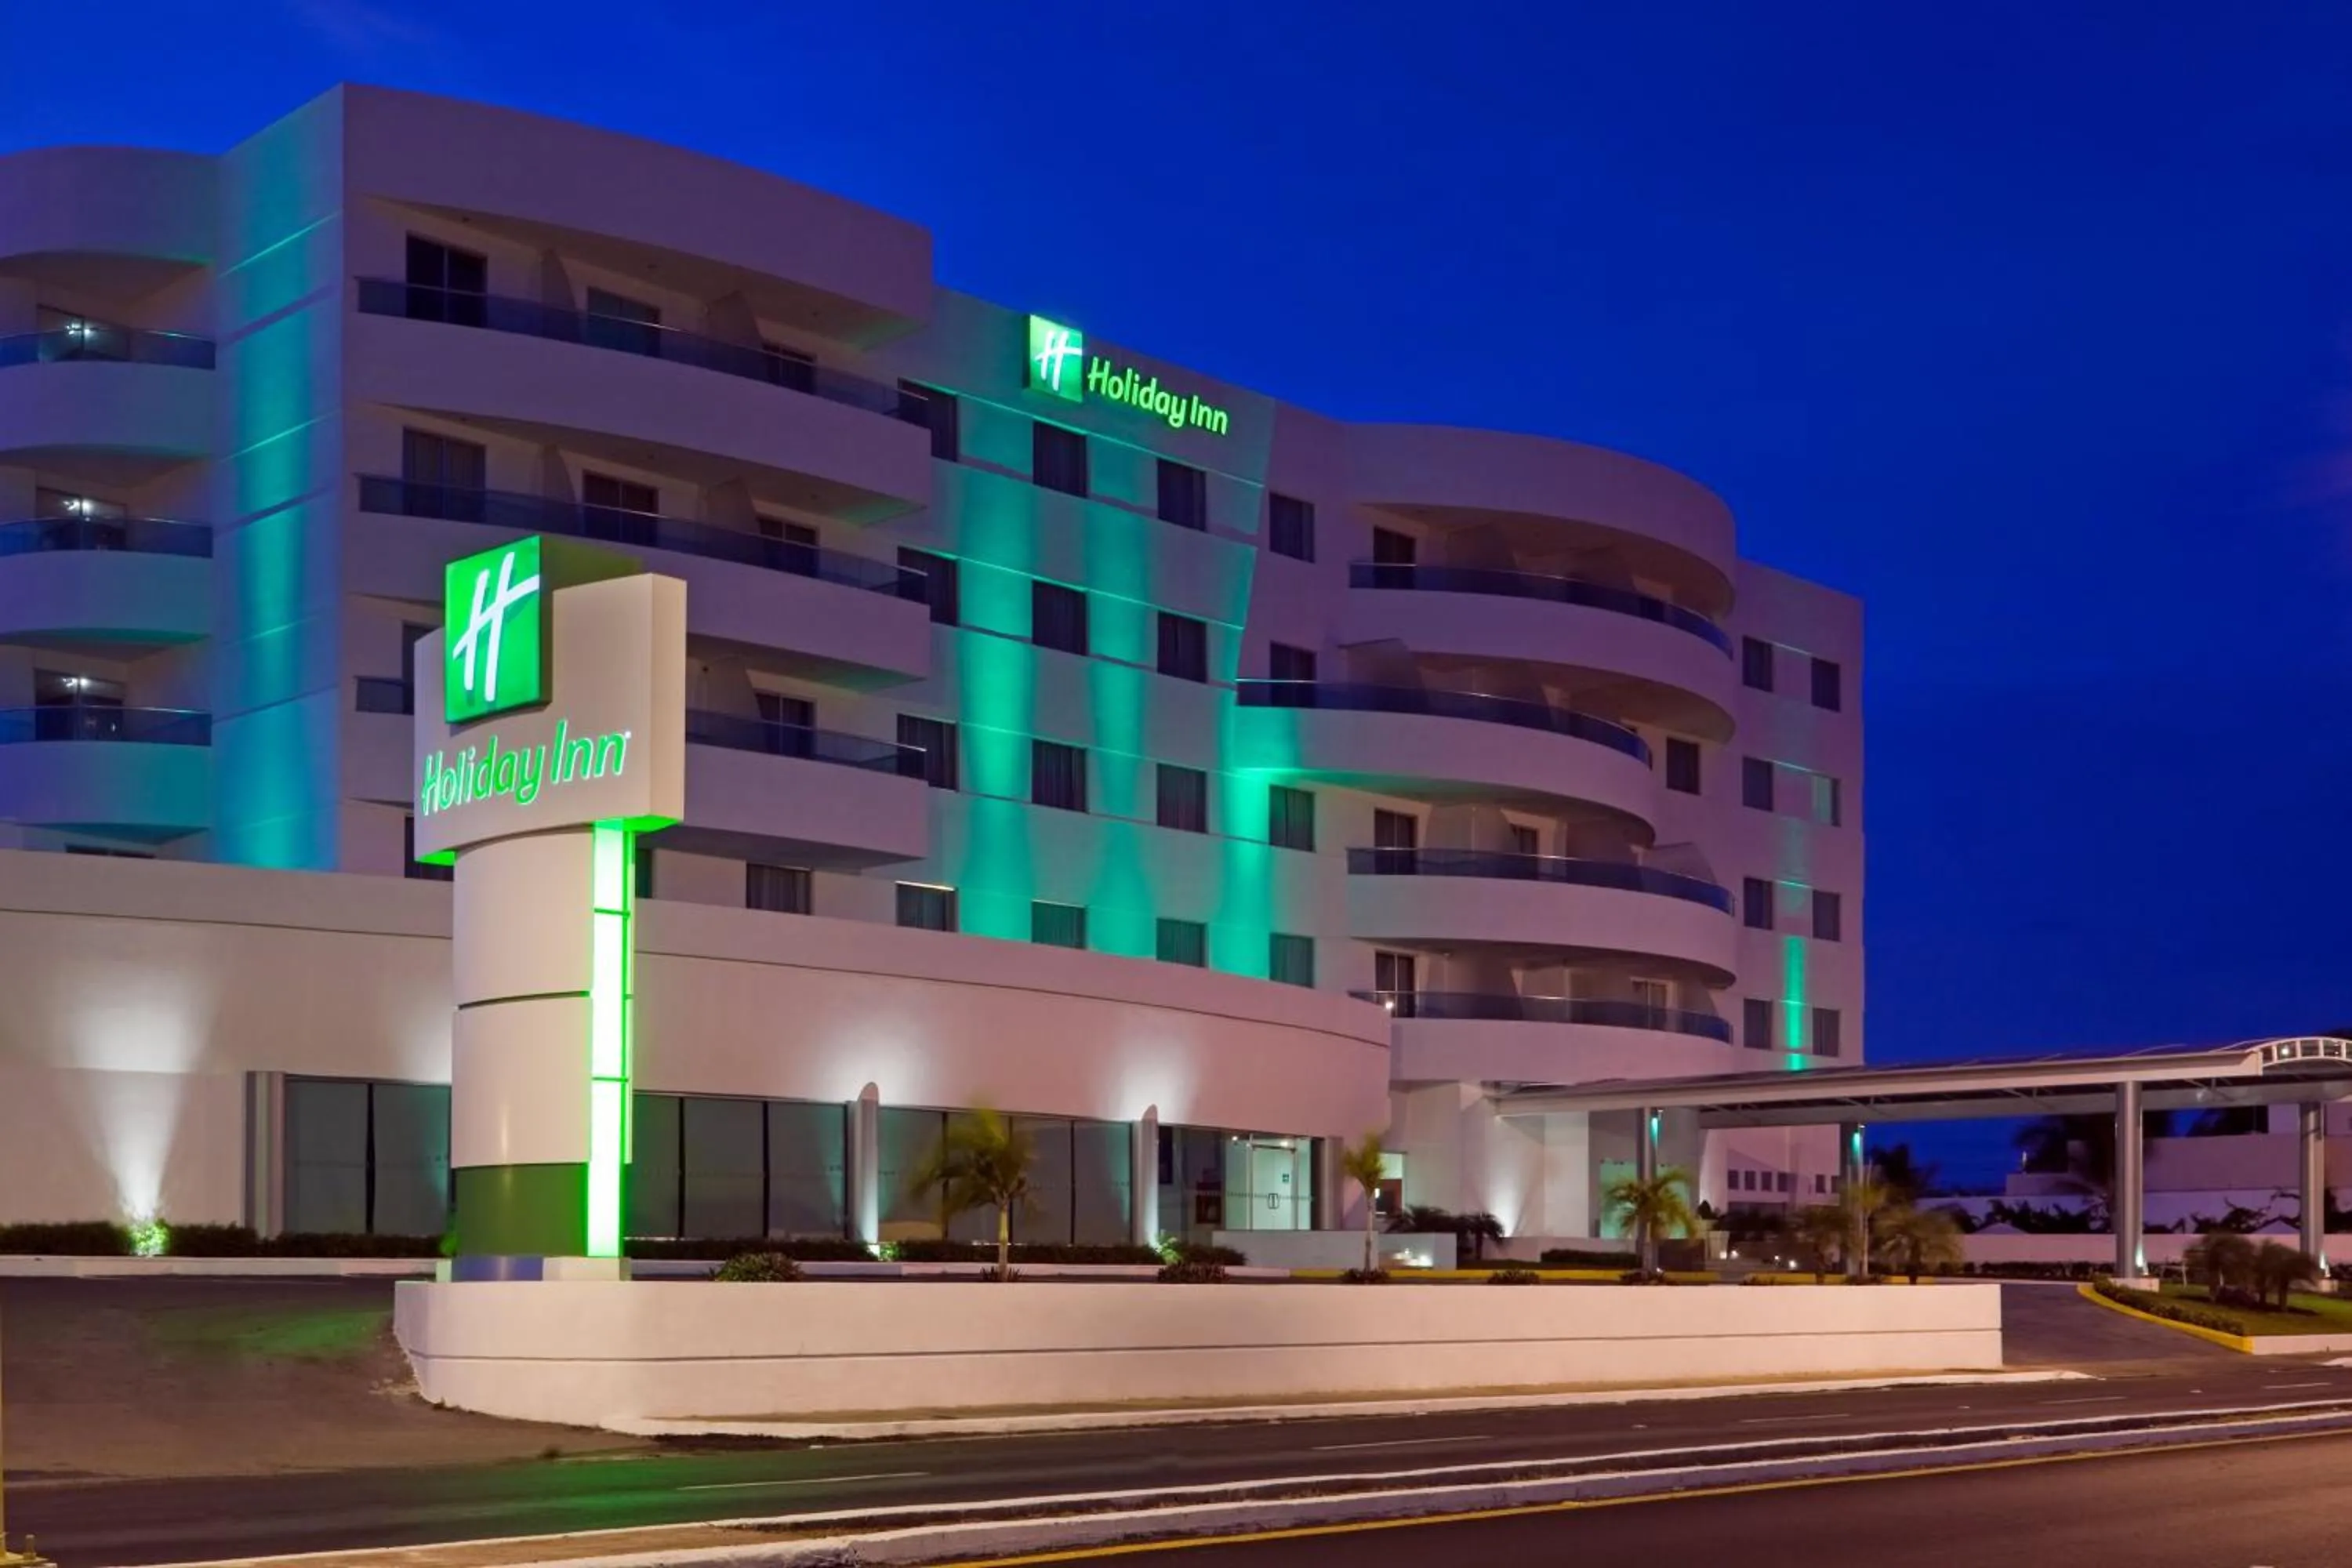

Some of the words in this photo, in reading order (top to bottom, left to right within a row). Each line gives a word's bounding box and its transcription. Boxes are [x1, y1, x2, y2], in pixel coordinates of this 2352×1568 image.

[1087, 356, 1187, 428] Holiday
[1189, 395, 1229, 435] Inn
[422, 735, 546, 815] Holiday
[551, 720, 626, 785] Inn
